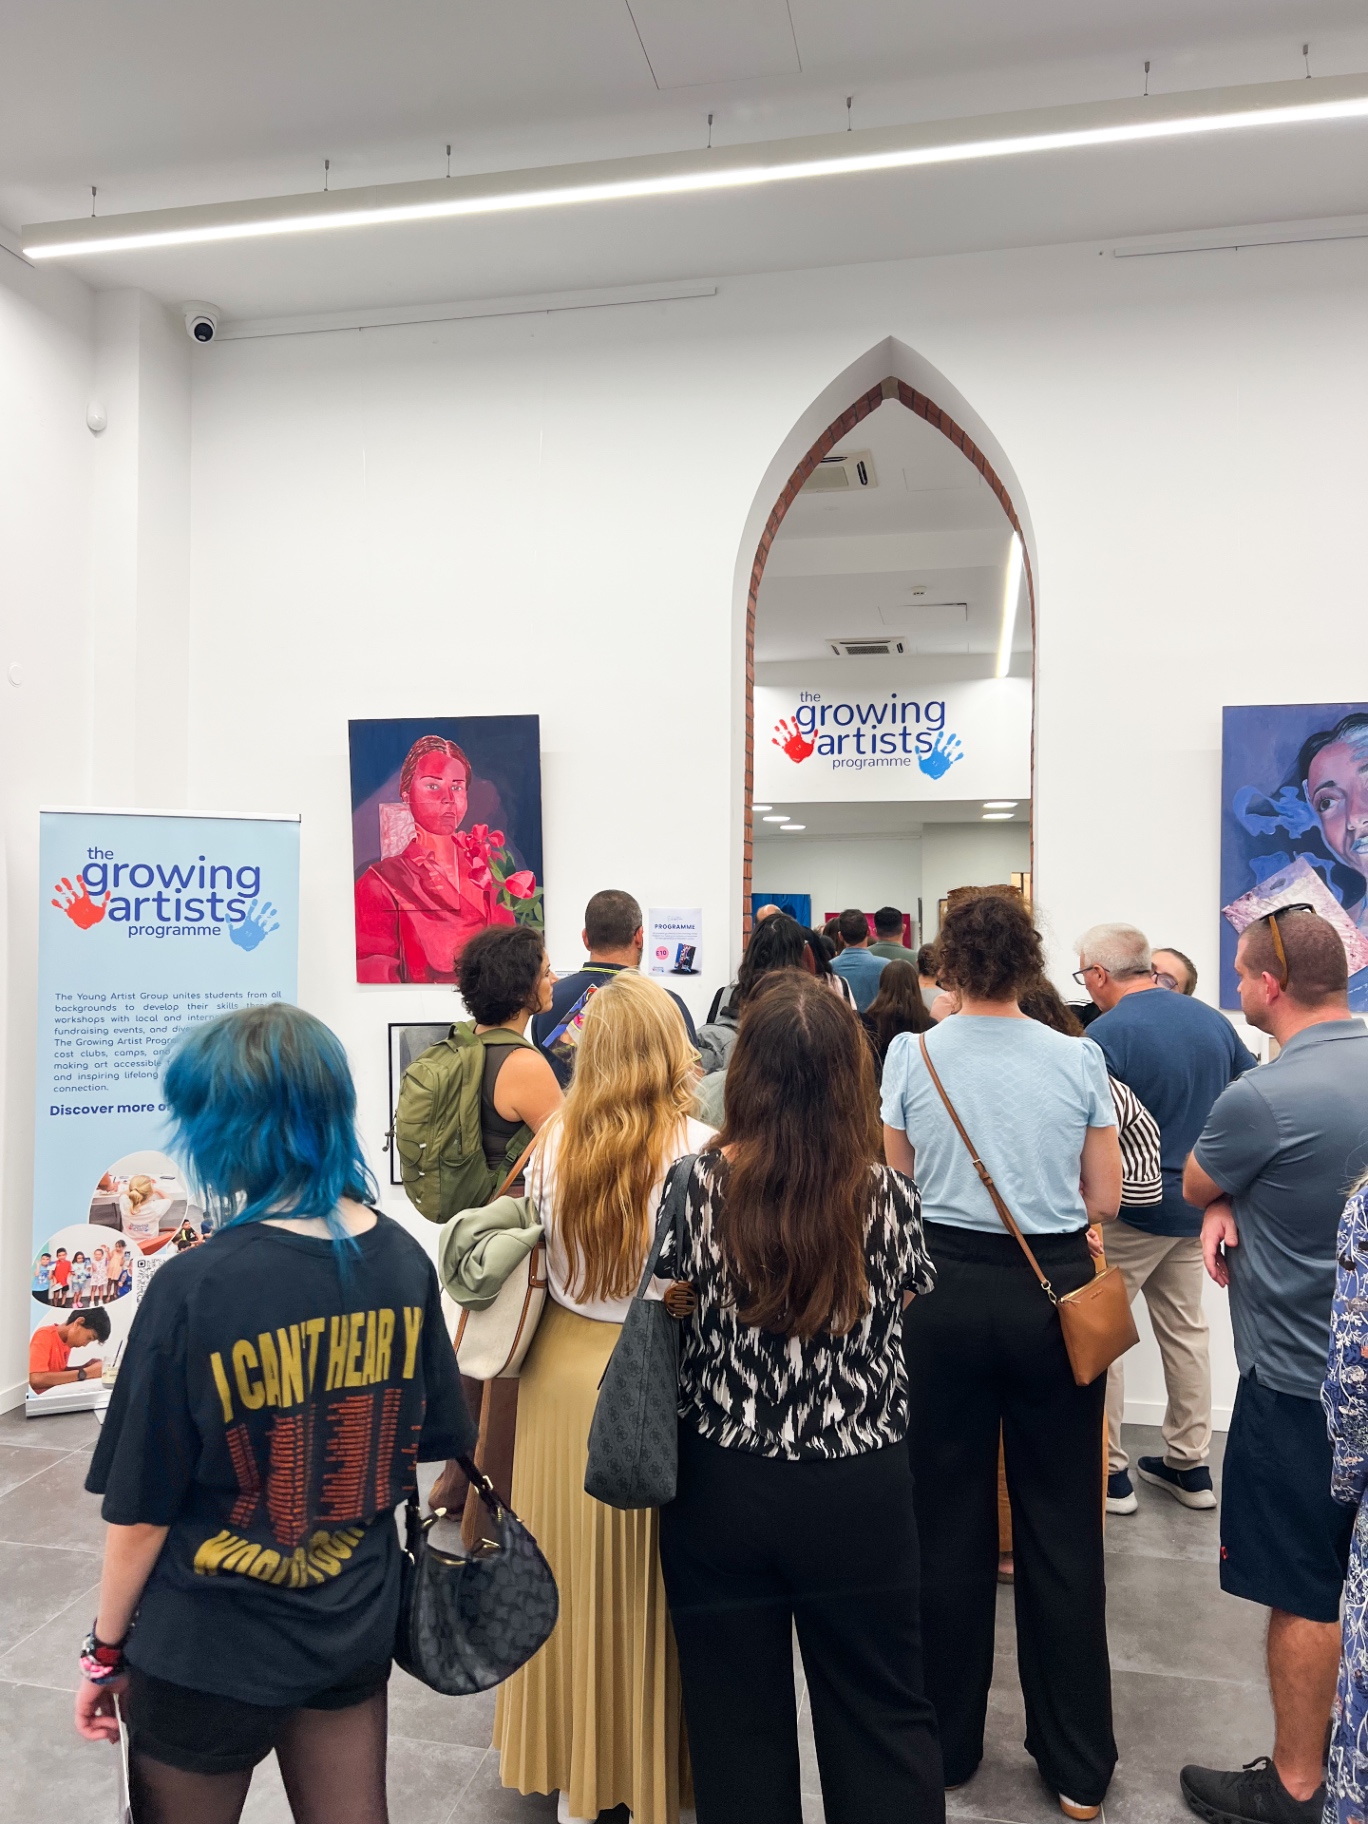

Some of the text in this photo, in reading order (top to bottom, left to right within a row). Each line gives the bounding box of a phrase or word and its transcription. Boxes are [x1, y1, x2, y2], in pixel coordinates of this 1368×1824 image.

[800, 691, 821, 702] the
[796, 693, 945, 735] growing
[817, 725, 934, 756] artists
[832, 756, 911, 770] programme
[87, 847, 114, 860] the
[81, 855, 261, 898] growing
[108, 888, 247, 923] artists
[128, 924, 221, 938] programme
[76, 993, 107, 1002] Young
[111, 992, 136, 1000] Artist
[140, 992, 169, 1002] Group
[247, 991, 268, 999] from
[55, 1004, 117, 1013] backgrounds
[143, 1003, 179, 1012] develop
[55, 1015, 105, 1024] workshops
[164, 1014, 182, 1022] and
[54, 1027, 109, 1036] fundraising
[76, 1038, 114, 1047] Growing
[54, 1050, 74, 1058] cost
[54, 1062, 88, 1070] making
[114, 1060, 162, 1068] accessible
[54, 1071, 159, 1081] and inspiring lifelong
[50, 1104, 114, 1116] Discover
[117, 1104, 155, 1113] more
[210, 1351, 234, 1424] I
[232, 1317, 326, 1411] CAN'T
[325, 1308, 396, 1392] HEAR
